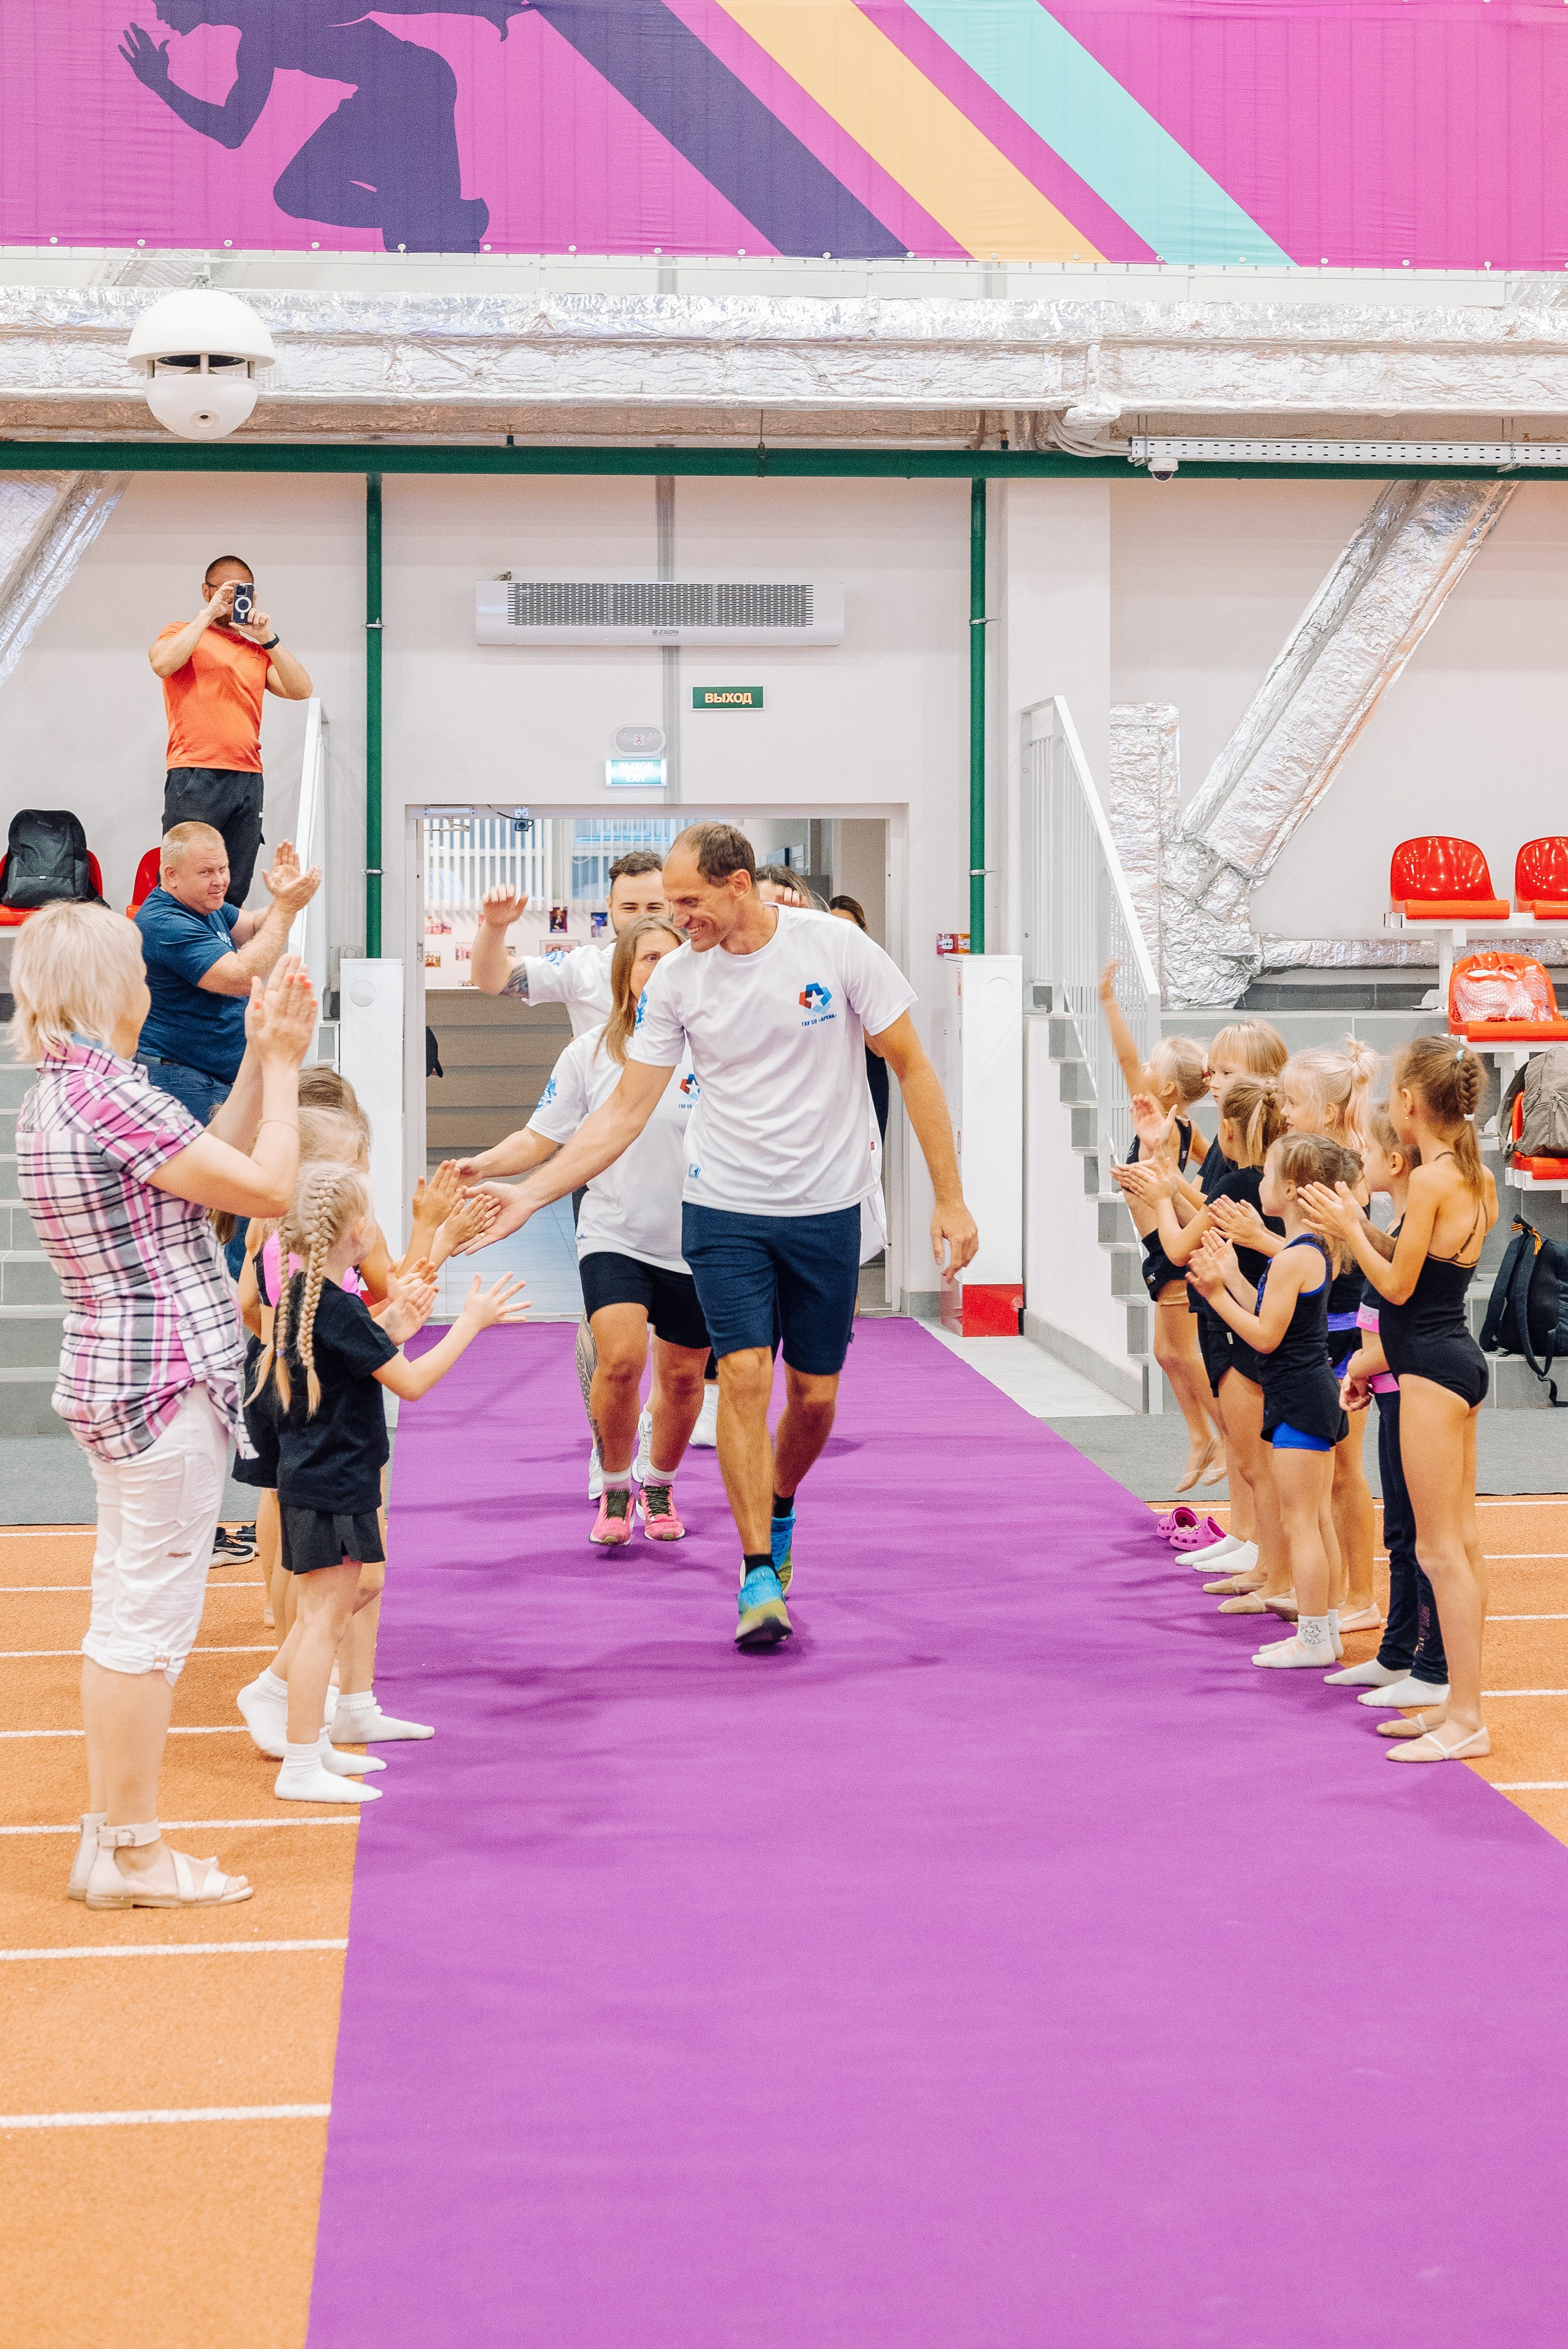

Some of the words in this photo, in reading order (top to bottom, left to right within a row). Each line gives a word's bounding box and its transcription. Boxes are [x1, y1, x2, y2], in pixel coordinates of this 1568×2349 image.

[704, 693, 752, 704] ВЫХОД
[619, 762, 654, 772] ВЫХОД
[626, 773, 646, 782] EXIT
